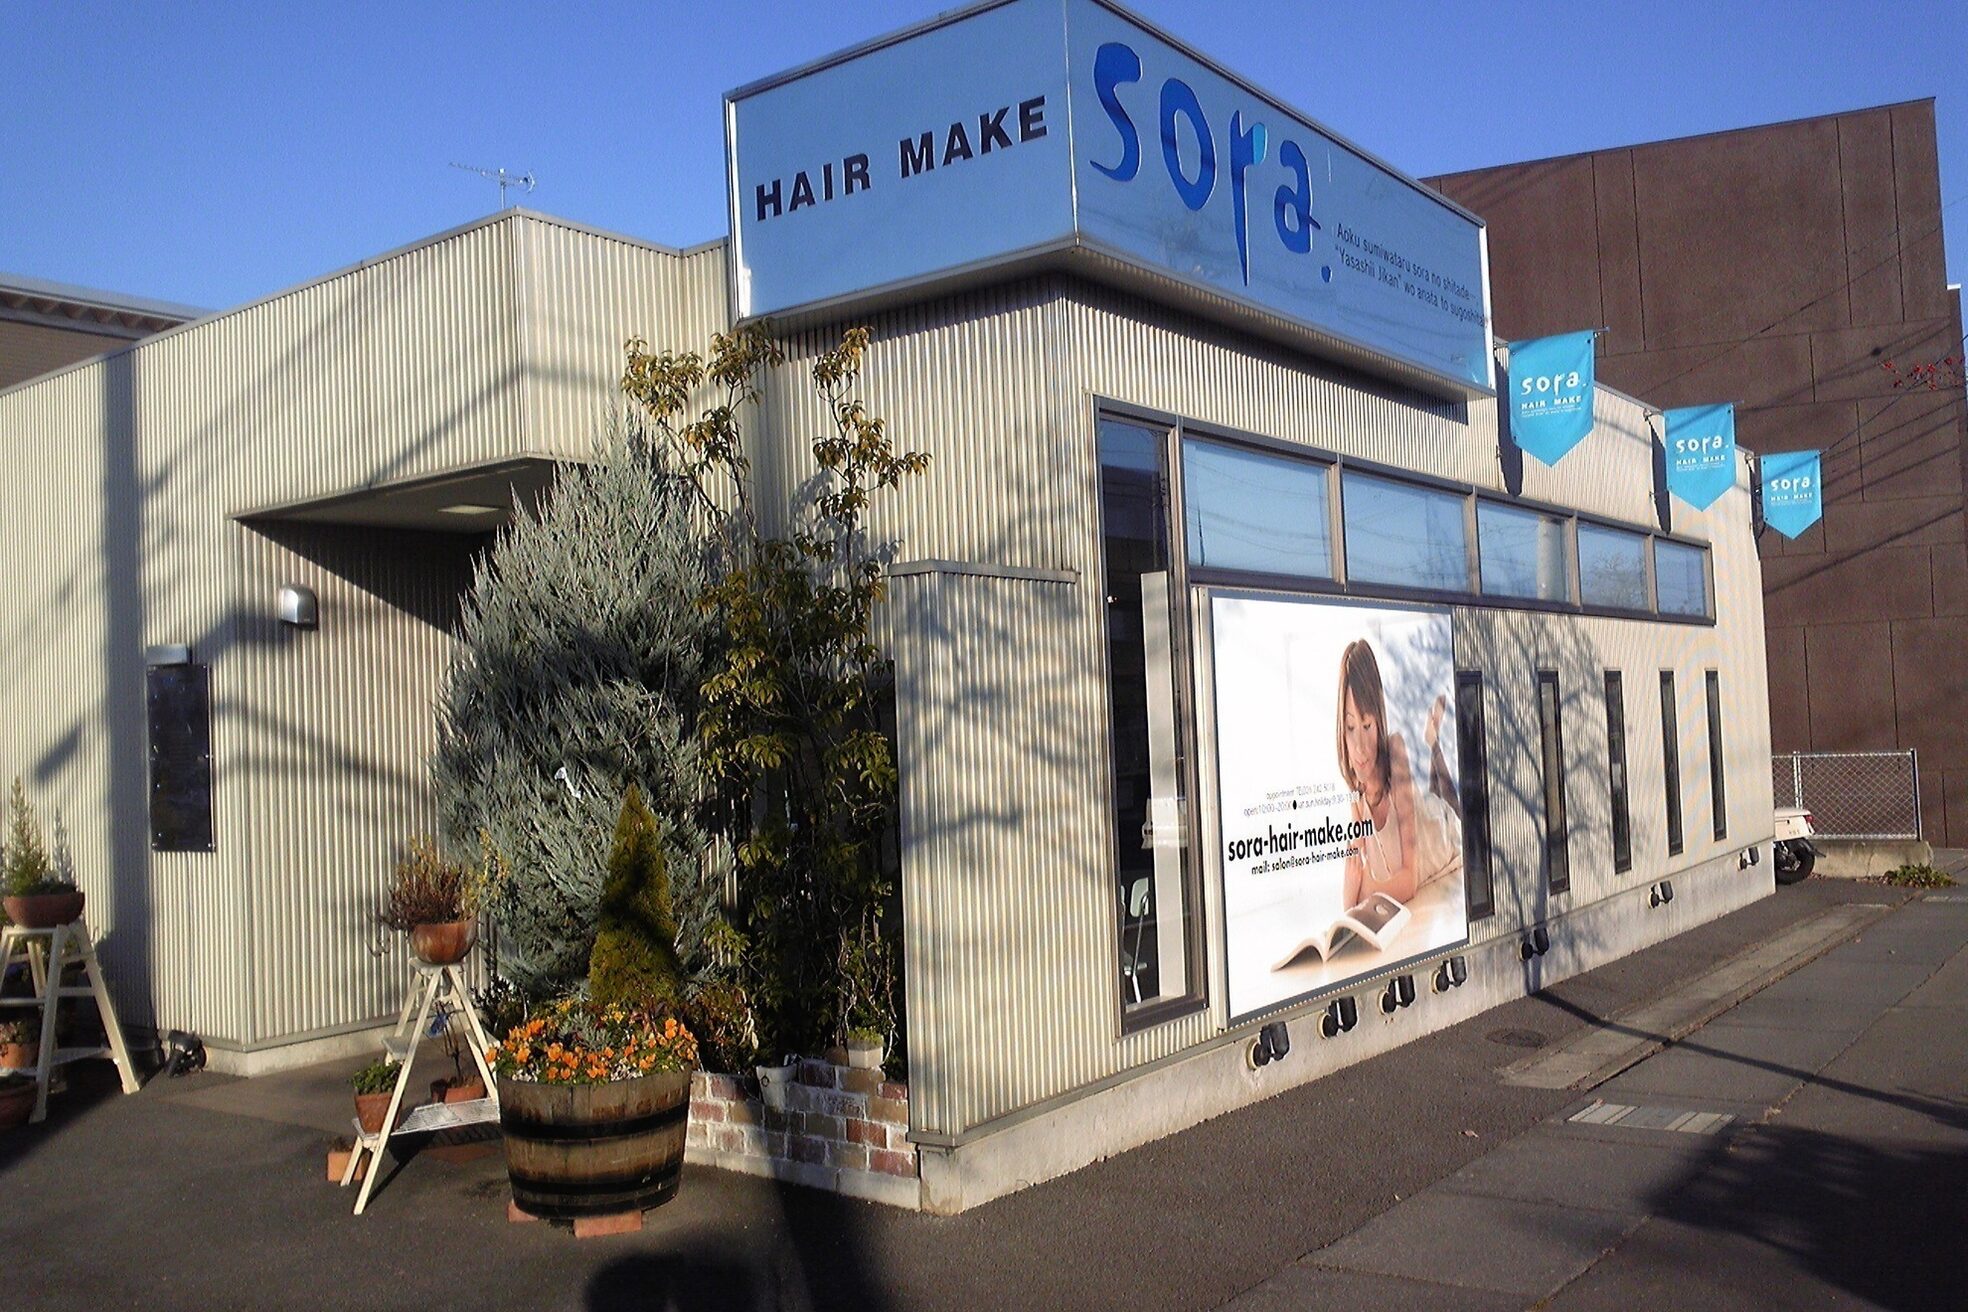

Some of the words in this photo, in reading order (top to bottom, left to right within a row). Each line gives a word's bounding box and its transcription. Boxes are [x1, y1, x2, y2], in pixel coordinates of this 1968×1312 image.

[756, 153, 872, 222] HAIR
[900, 95, 1048, 180] MAKE
[1337, 223, 1360, 248] Aoku
[1363, 239, 1410, 272] sumiwataru
[1412, 263, 1429, 281] sora
[1431, 272, 1441, 287] no
[1404, 282, 1416, 296] wo
[1417, 287, 1438, 307] anata
[1441, 295, 1449, 311] to
[1521, 400, 1546, 410] HAIR
[1554, 395, 1582, 405] MAKE
[1676, 457, 1697, 465] HAIR
[1703, 454, 1726, 462] MAKE
[1228, 815, 1373, 862] sora-hair-make.com
[1251, 860, 1270, 875] mail:
[1271, 846, 1359, 872] salon@sora-hair-make.com
